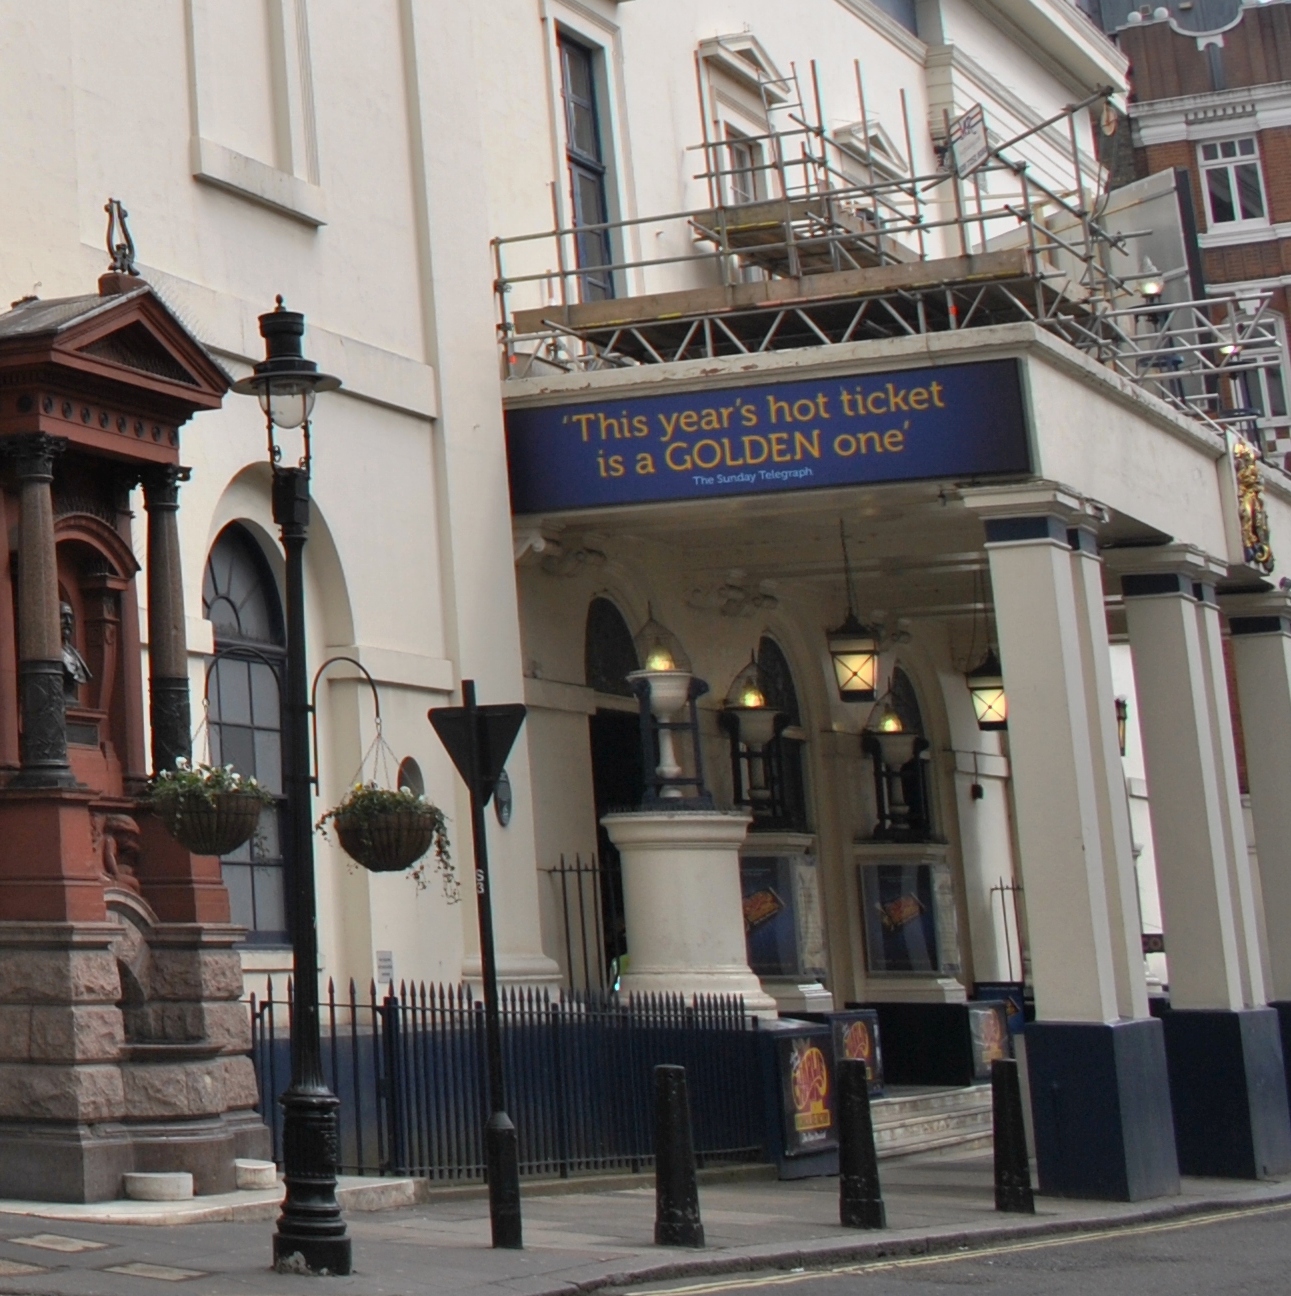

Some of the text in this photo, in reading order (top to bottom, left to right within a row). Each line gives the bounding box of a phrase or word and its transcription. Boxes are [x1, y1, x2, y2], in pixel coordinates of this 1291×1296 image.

[656, 398, 759, 442] year's
[766, 391, 830, 425] hot
[839, 379, 946, 417] ticket
[596, 446, 626, 479] is
[633, 452, 656, 475] a
[664, 428, 824, 473] GOLDEN
[692, 465, 814, 488] The Sunday Telegraph
